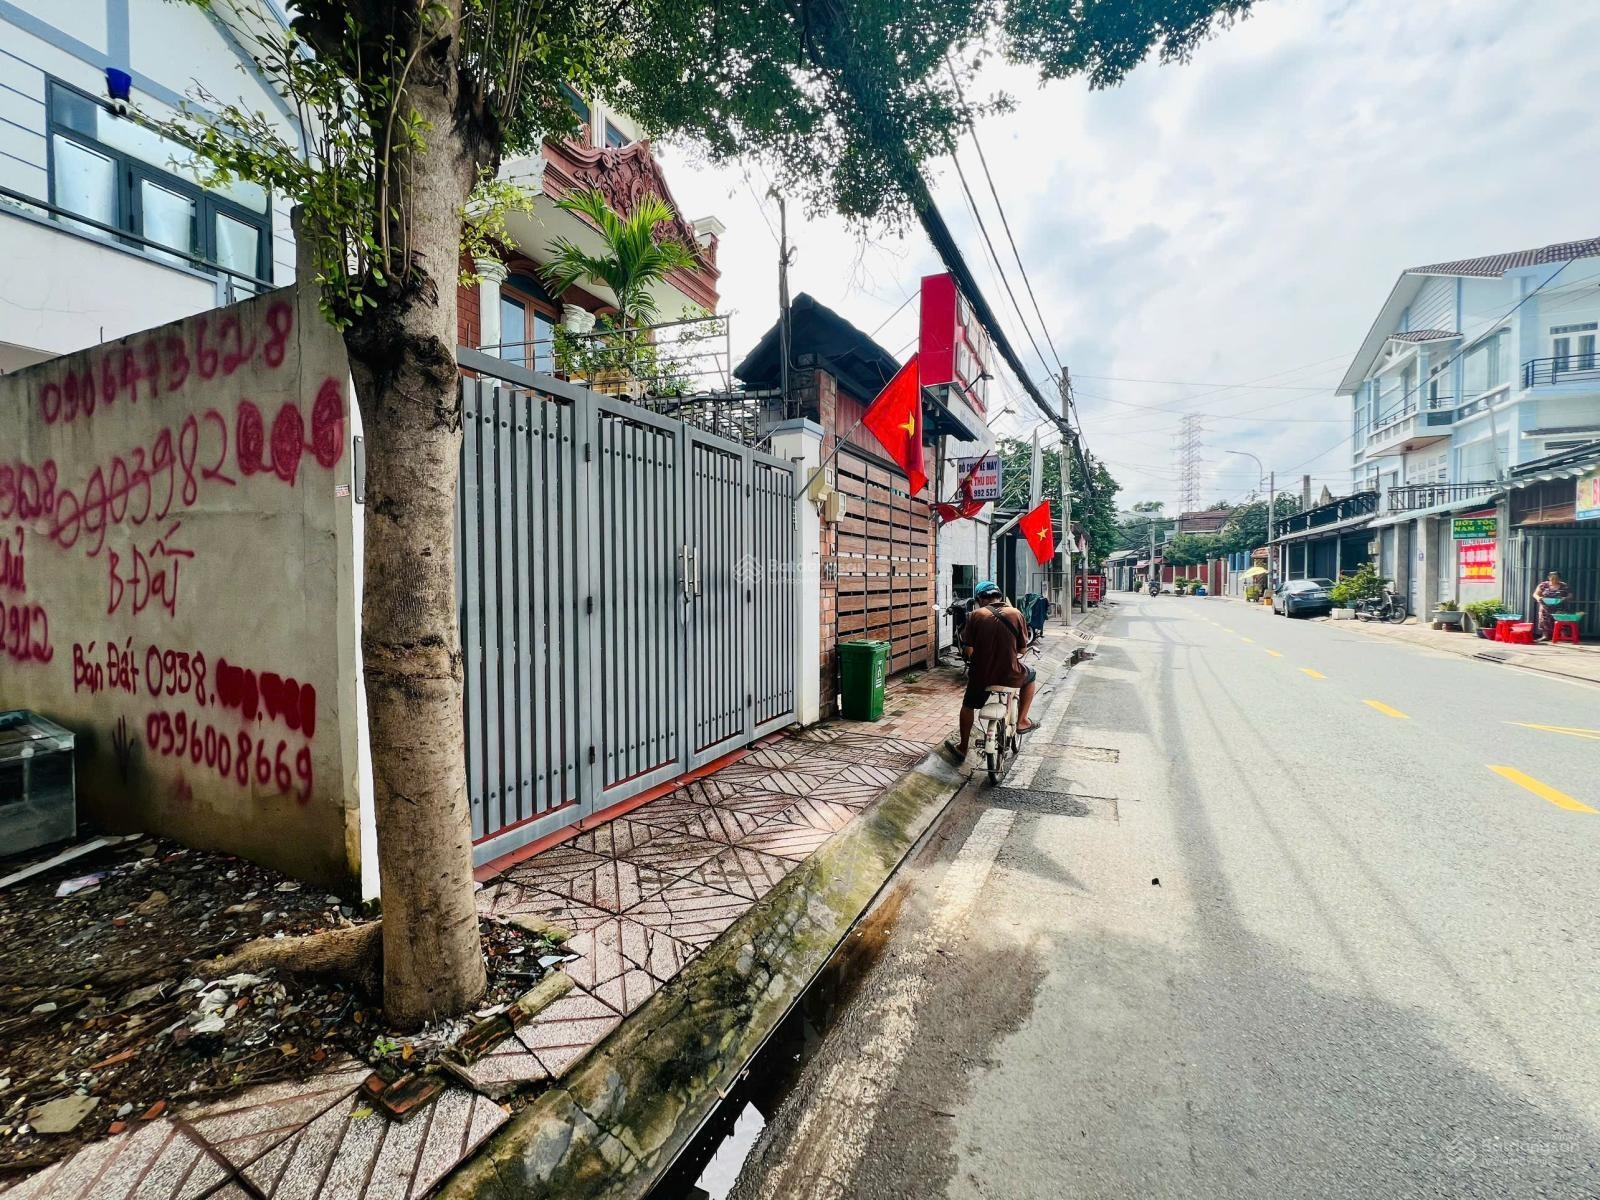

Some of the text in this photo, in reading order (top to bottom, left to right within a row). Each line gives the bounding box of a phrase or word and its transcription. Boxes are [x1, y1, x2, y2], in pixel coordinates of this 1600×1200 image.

[73, 640, 103, 694] Bán
[107, 636, 139, 695] Đất
[147, 710, 313, 804] 0396008669
